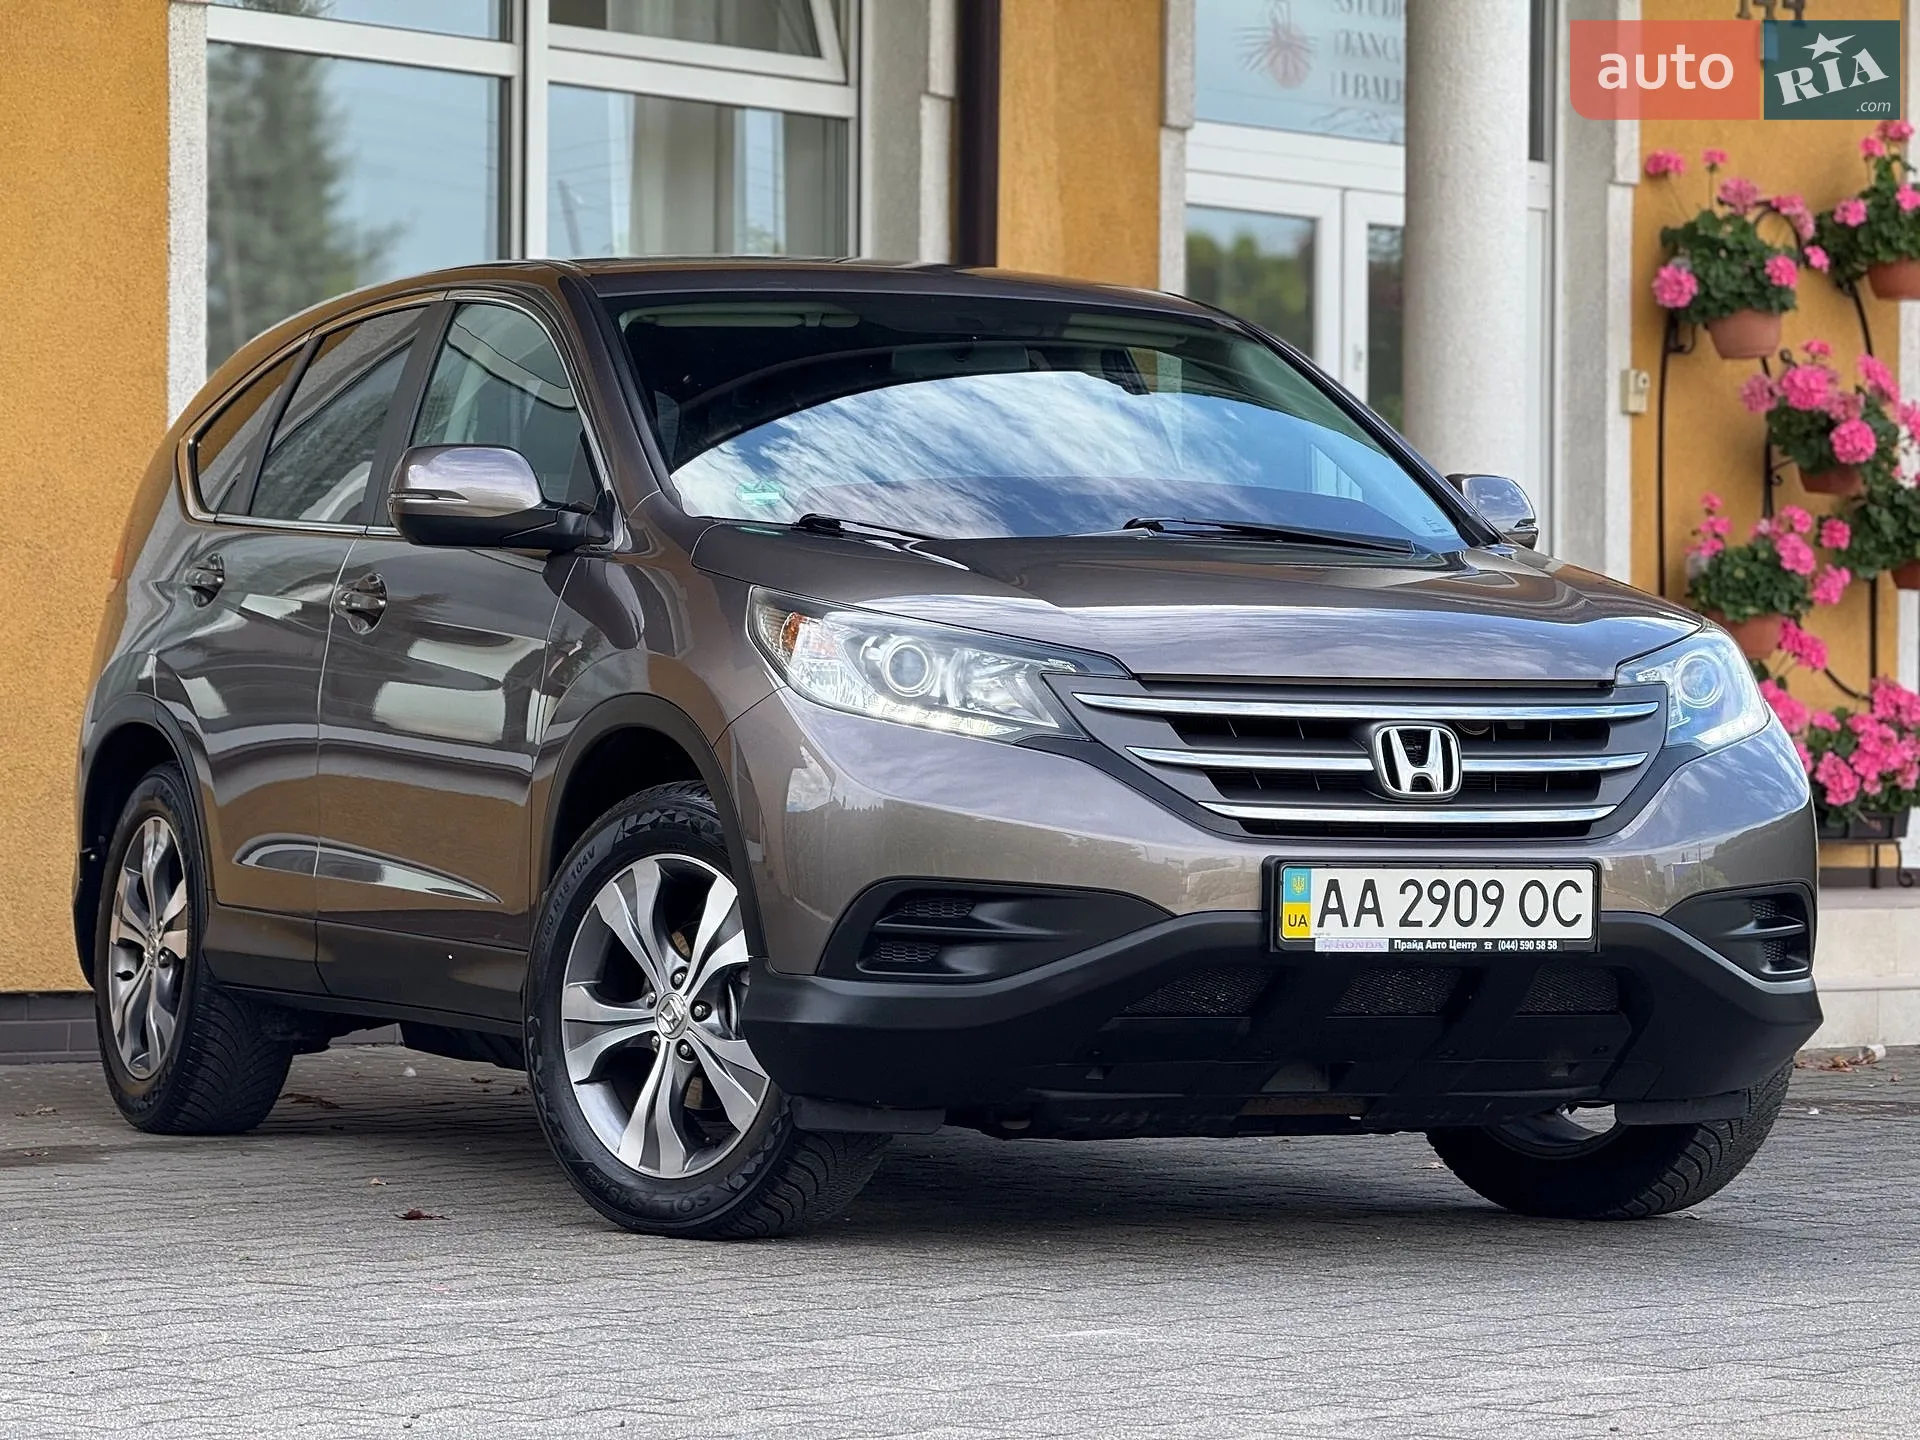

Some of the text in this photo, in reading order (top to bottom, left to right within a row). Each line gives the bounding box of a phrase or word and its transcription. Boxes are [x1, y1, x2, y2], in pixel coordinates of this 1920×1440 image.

[1316, 878, 1584, 929] AA 2909 OC
[1287, 914, 1308, 928] UA
[1394, 939, 1557, 952] Прайд Авто Центр (044) 590 58 58
